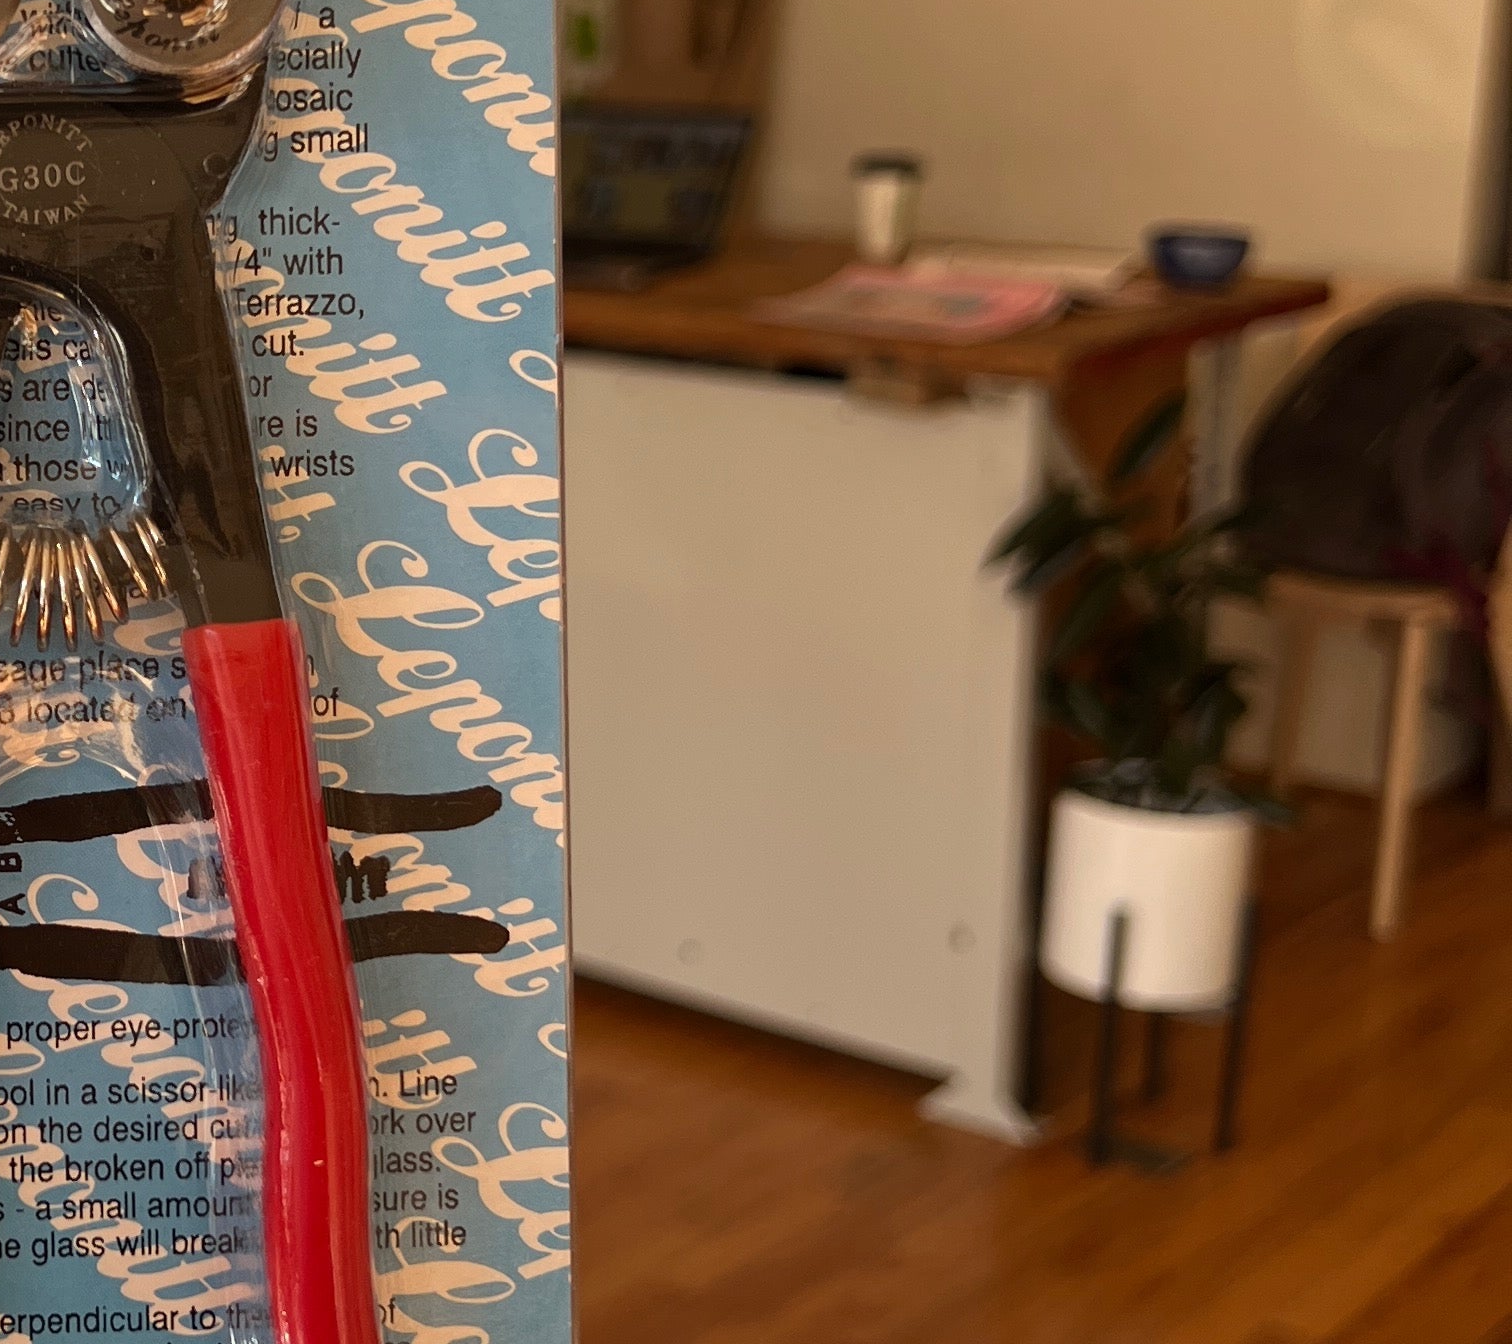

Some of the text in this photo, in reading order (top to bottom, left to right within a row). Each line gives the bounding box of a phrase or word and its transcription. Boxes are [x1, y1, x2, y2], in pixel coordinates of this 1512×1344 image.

[319, 6, 336, 30] a
[274, 41, 362, 77] ecially
[270, 81, 354, 112] osaic
[290, 123, 368, 154] small
[2, 193, 90, 226] TAIWAN
[258, 206, 341, 236] thick-
[283, 246, 344, 275] with
[236, 288, 366, 320] Terrazzo,
[251, 329, 305, 357] cut.
[22, 377, 70, 402] are
[295, 408, 318, 437] is
[14, 449, 355, 483] those wrists
[313, 687, 339, 716] of
[6, 1018, 100, 1050] proper
[45, 1077, 70, 1105] in
[80, 1082, 98, 1105] a
[398, 1069, 459, 1098] Line
[37, 1116, 82, 1143] the
[93, 1113, 198, 1143] desired
[371, 1107, 404, 1135] ork
[415, 1109, 477, 1135] over
[8, 1155, 55, 1184] the
[64, 1151, 165, 1182] broken
[175, 1150, 209, 1181] off
[35, 1197, 52, 1221] a
[62, 1190, 137, 1221] small
[437, 1183, 460, 1210] is
[31, 1232, 106, 1266] glass
[116, 1228, 161, 1257] will
[411, 1222, 468, 1247] little
[189, 1305, 217, 1330] to
